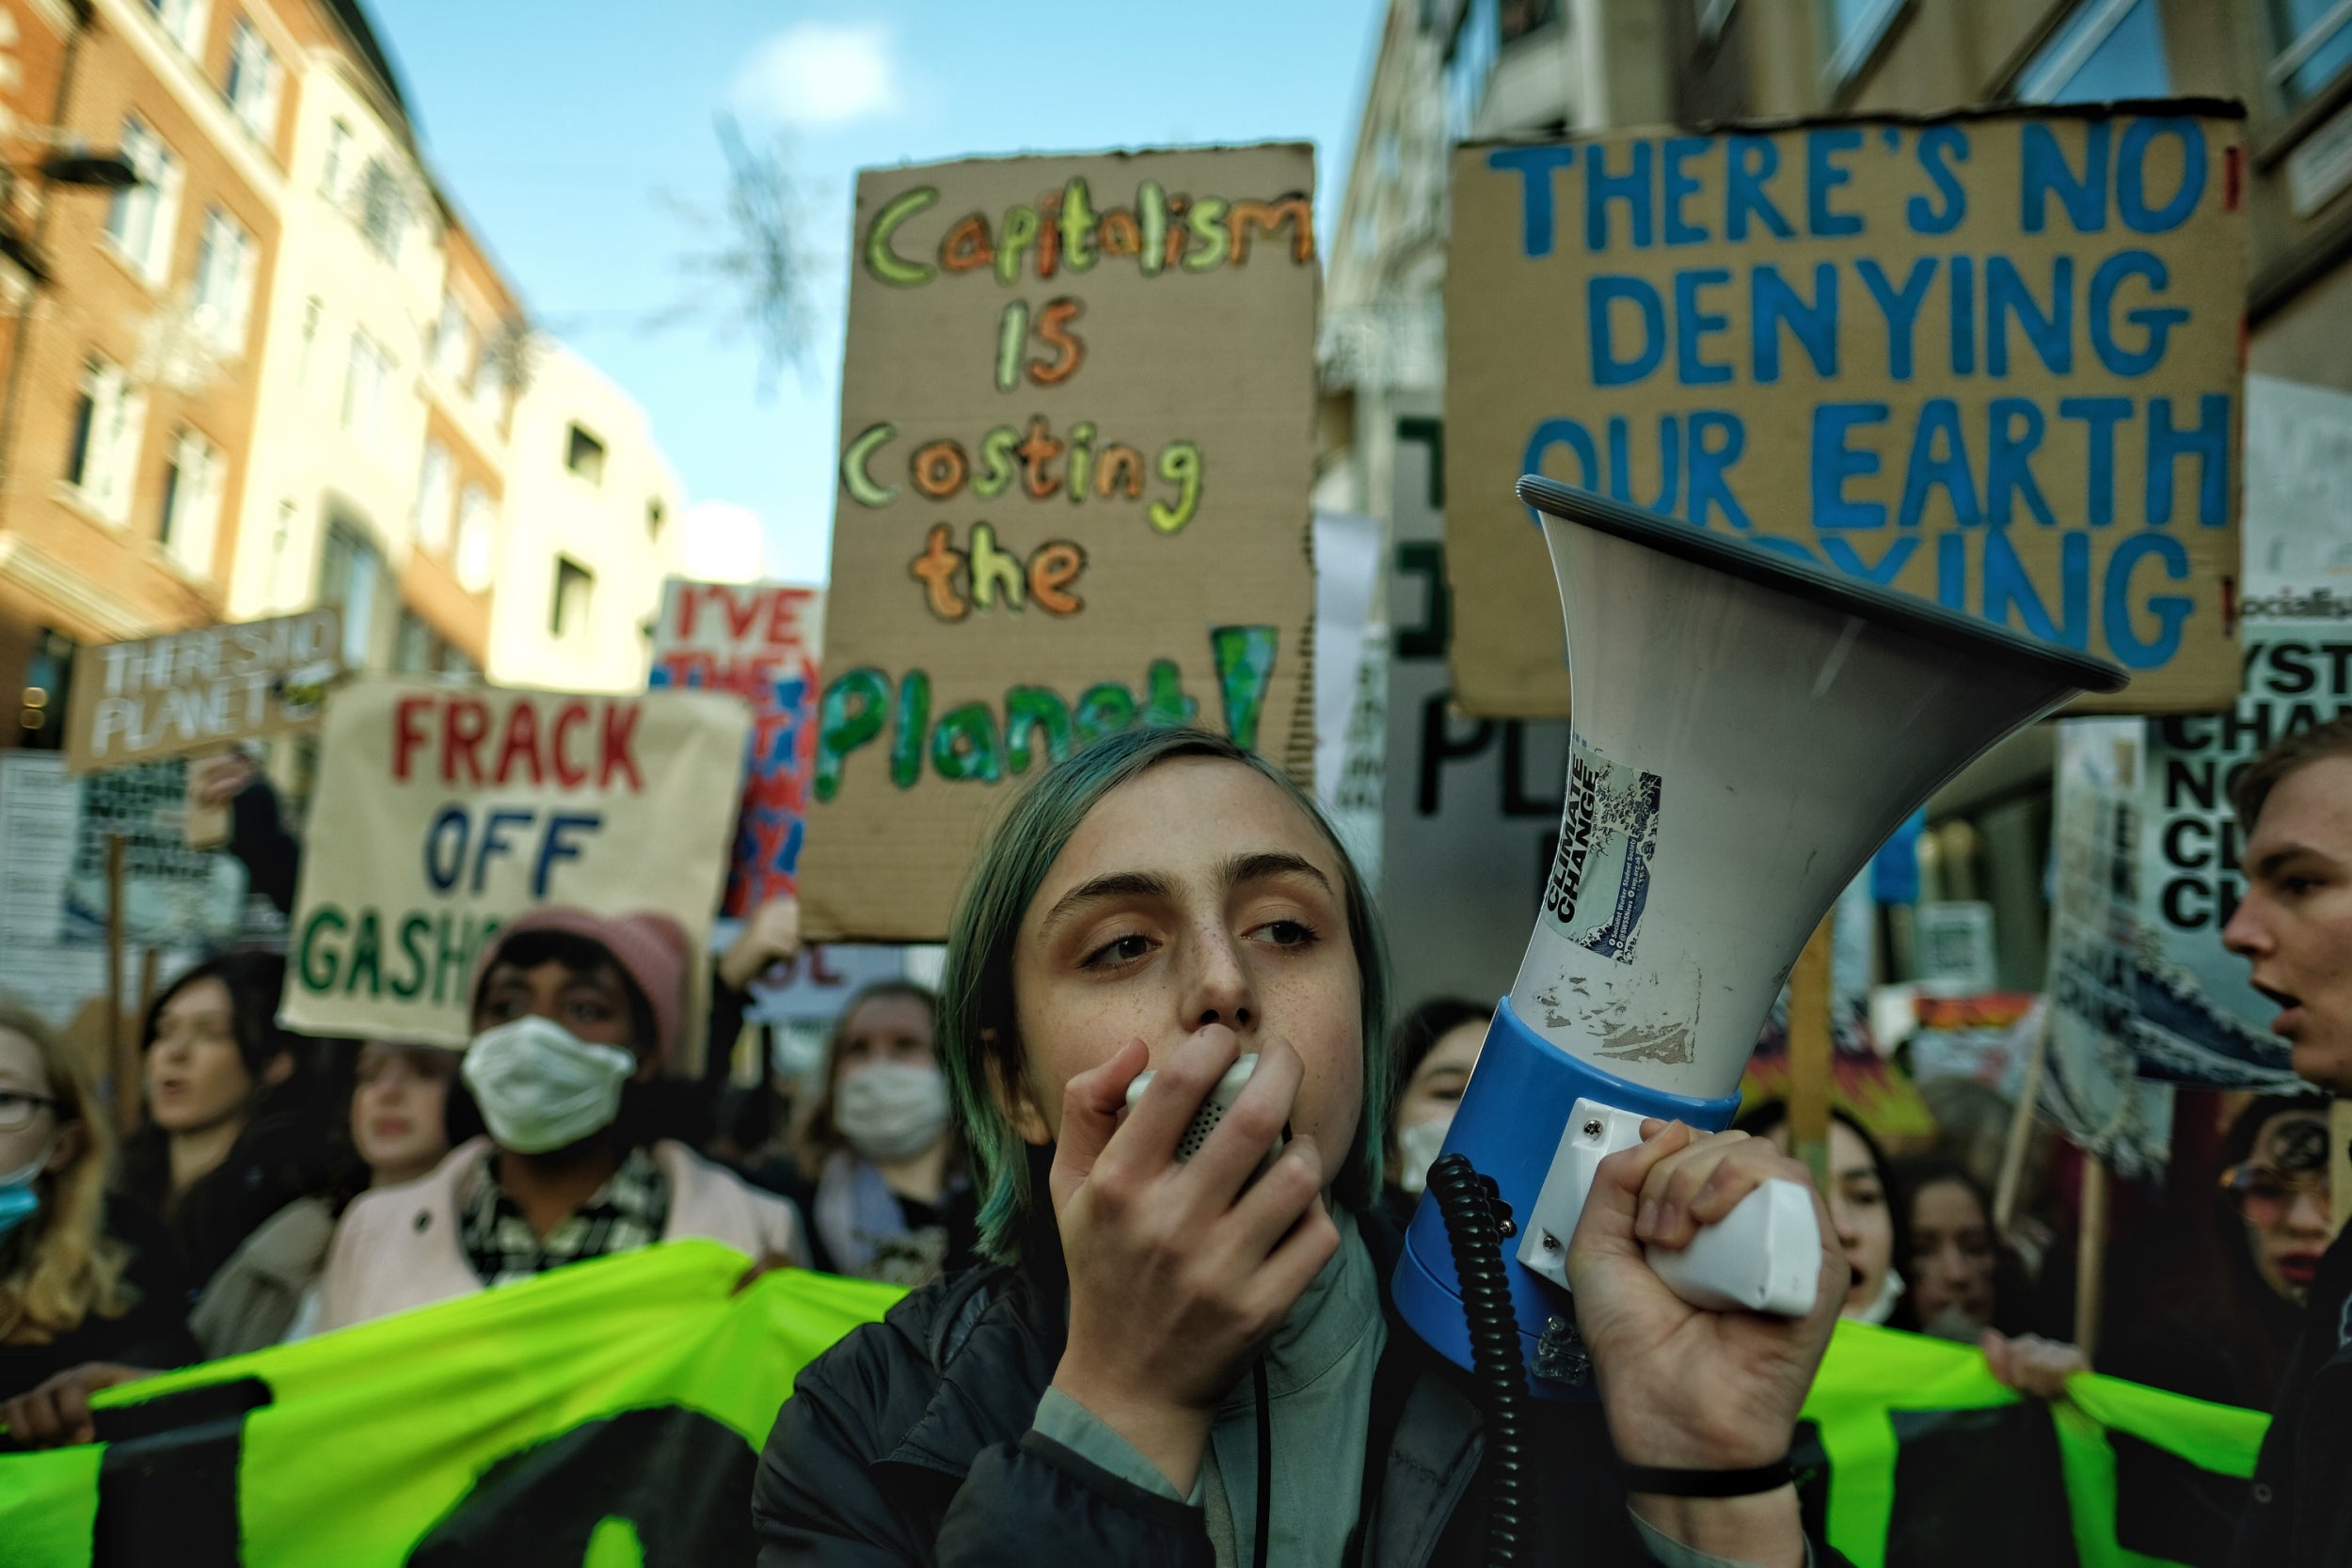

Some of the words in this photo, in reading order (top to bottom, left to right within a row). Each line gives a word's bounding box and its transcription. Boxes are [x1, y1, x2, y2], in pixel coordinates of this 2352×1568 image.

[864, 176, 1314, 286] Capitalism
[1487, 123, 1972, 258] THERE'S
[2019, 113, 2209, 235] NO
[1587, 247, 2192, 388] DENYING
[841, 414, 1204, 534] Costing
[1522, 409, 1756, 534] OUR
[1809, 393, 2230, 531] EARTH
[674, 584, 814, 647] I'VE
[909, 518, 1089, 623] the
[1745, 527, 2194, 670] YING
[2242, 641, 2352, 694] YST
[390, 696, 645, 795] FRACK
[422, 802, 605, 900] OFF
[1547, 752, 1583, 912] CLIMATE
[1557, 767, 1599, 924] CHANGE
[1623, 862, 1632, 886] Student
[1627, 838, 1637, 861] Society
[1612, 911, 1622, 938] Socialist
[1617, 888, 1628, 911] Worker
[300, 903, 502, 1004] GASH
